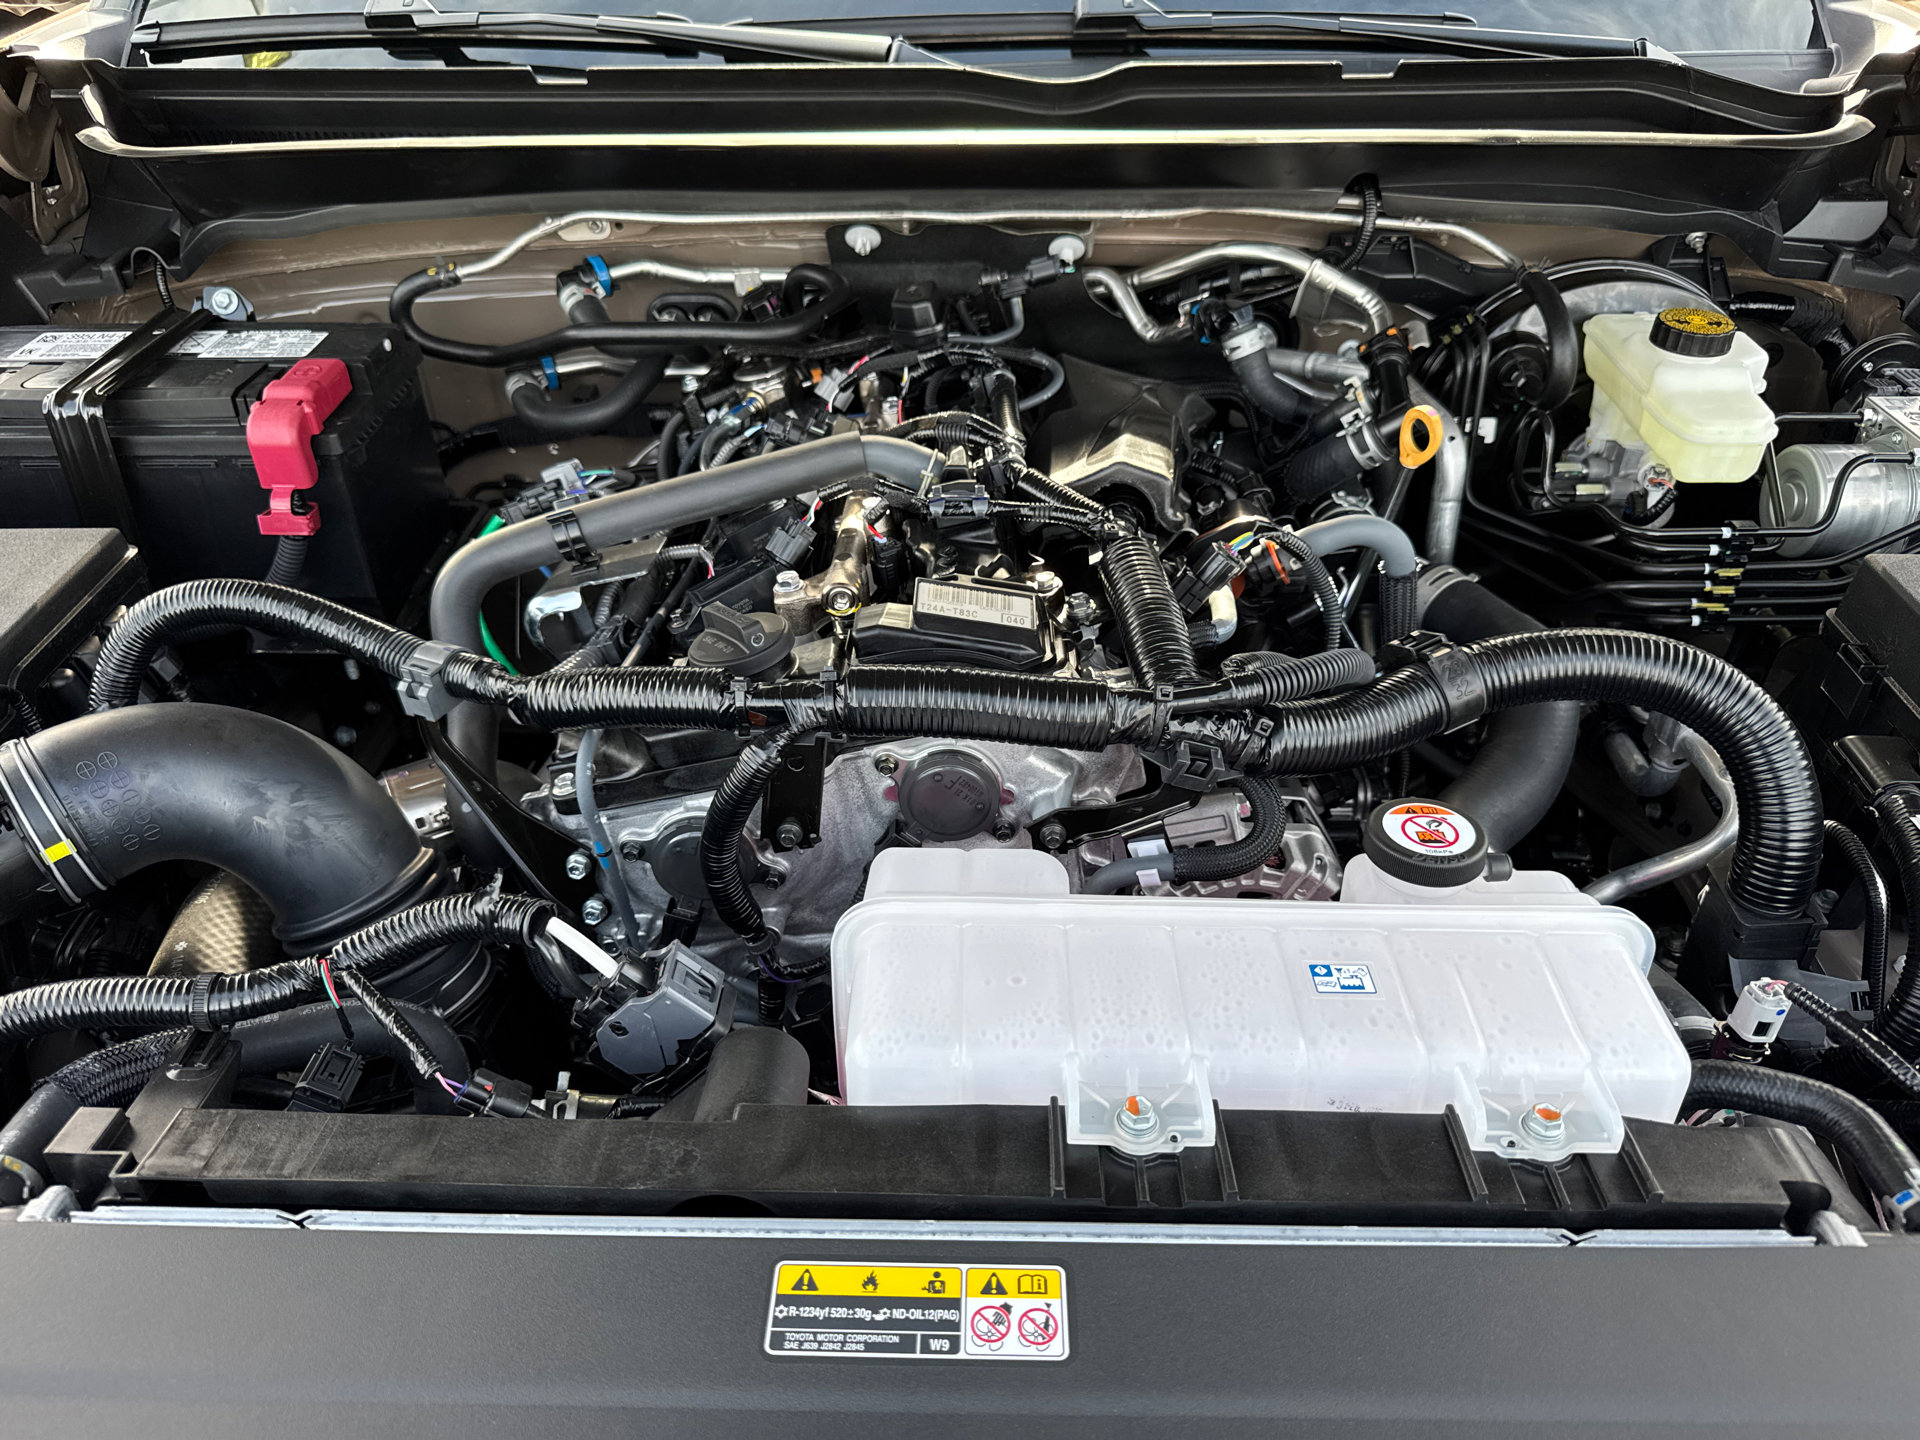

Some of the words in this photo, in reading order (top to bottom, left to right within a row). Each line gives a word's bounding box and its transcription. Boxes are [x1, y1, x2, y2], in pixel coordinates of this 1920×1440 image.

[920, 602, 978, 619] T24A-T83C
[1006, 615, 1026, 626] 040
[789, 1307, 829, 1320] R-1234yf
[830, 1307, 872, 1321] 520±30g
[892, 1309, 959, 1322] ND-OIL12(PAG)
[785, 1333, 815, 1341] TOYOTA
[816, 1333, 844, 1341] MOTOR
[846, 1334, 900, 1343] CORPORATION
[784, 1342, 799, 1350] SAE
[801, 1342, 818, 1350] J639
[929, 1339, 949, 1351] W9
